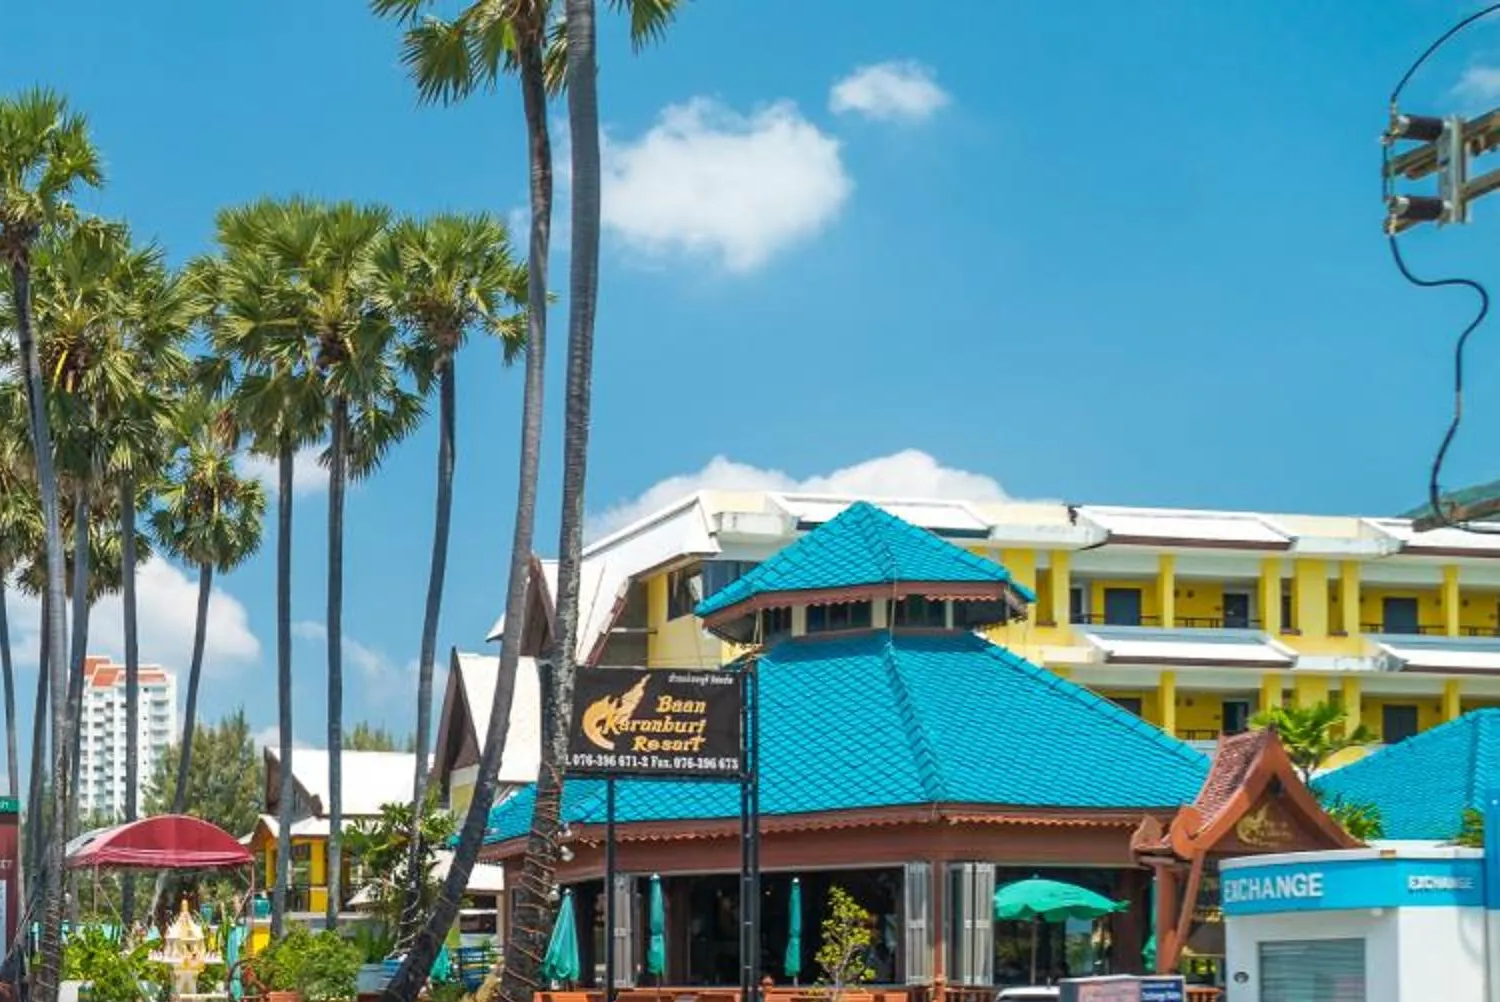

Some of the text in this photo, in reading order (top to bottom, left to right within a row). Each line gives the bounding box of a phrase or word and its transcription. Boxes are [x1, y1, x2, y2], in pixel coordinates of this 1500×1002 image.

[656, 695, 706, 714] Baan
[631, 735, 707, 752] Resort
[1224, 873, 1324, 902] EXCHANGE
[1407, 875, 1475, 890] EXCHANGE
